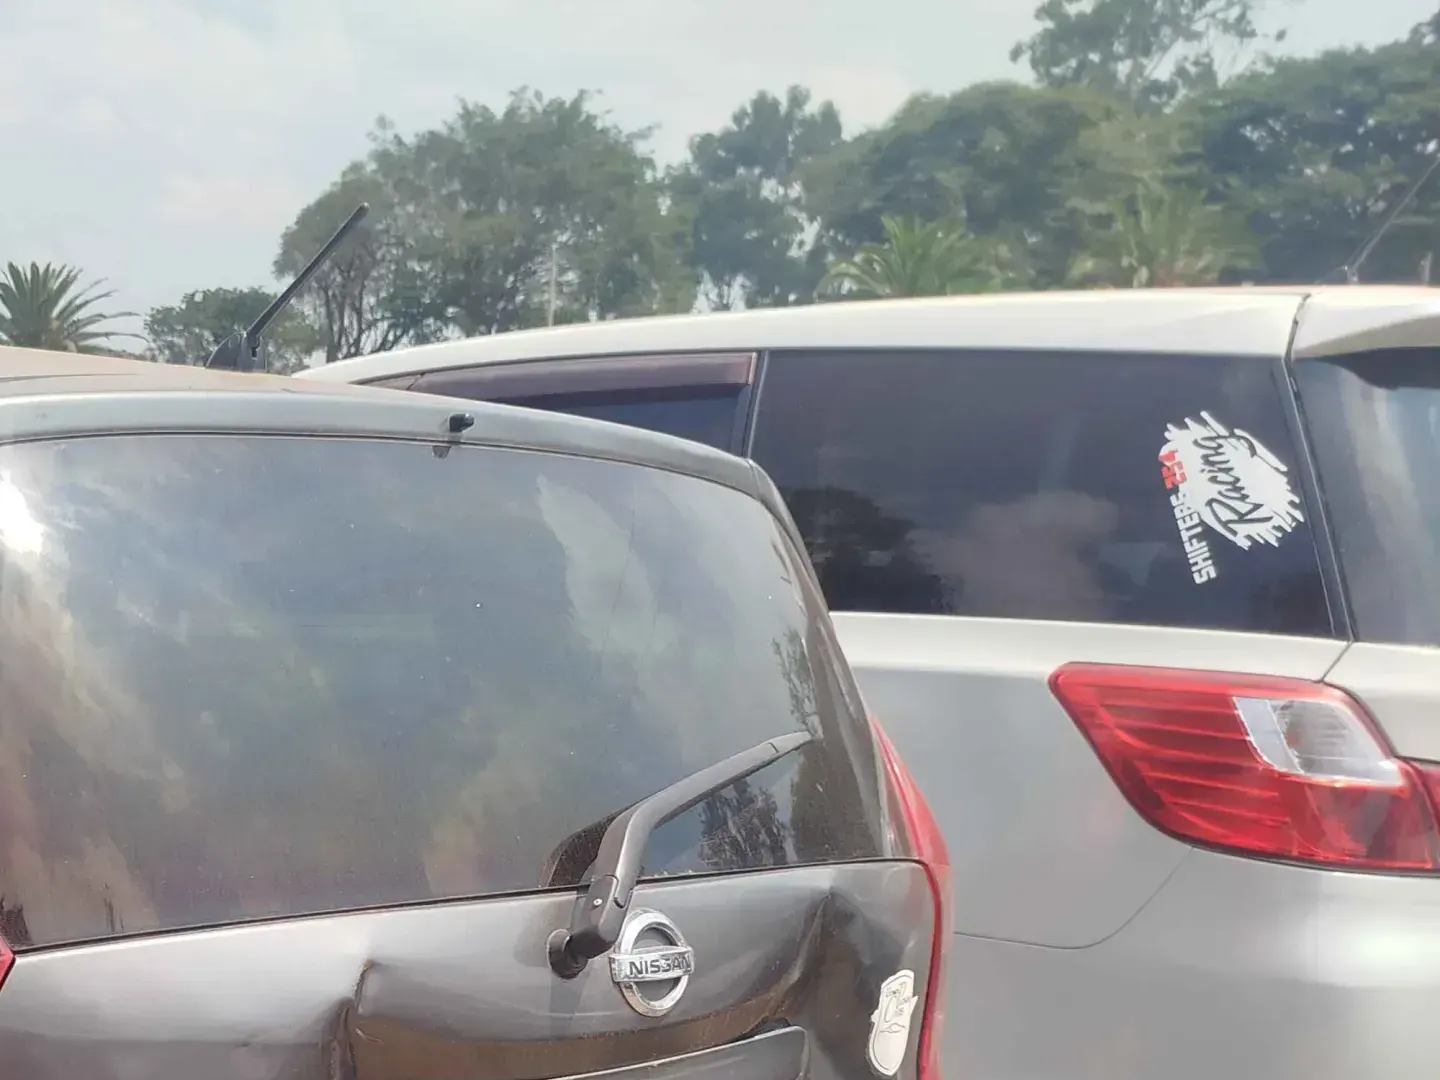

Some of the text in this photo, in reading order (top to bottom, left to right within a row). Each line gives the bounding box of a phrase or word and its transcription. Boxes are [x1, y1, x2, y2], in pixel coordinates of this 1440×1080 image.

[1159, 448, 1216, 585] SHIFTERS 254
[1193, 435, 1274, 538] Racing
[628, 954, 692, 976] NISSAN
